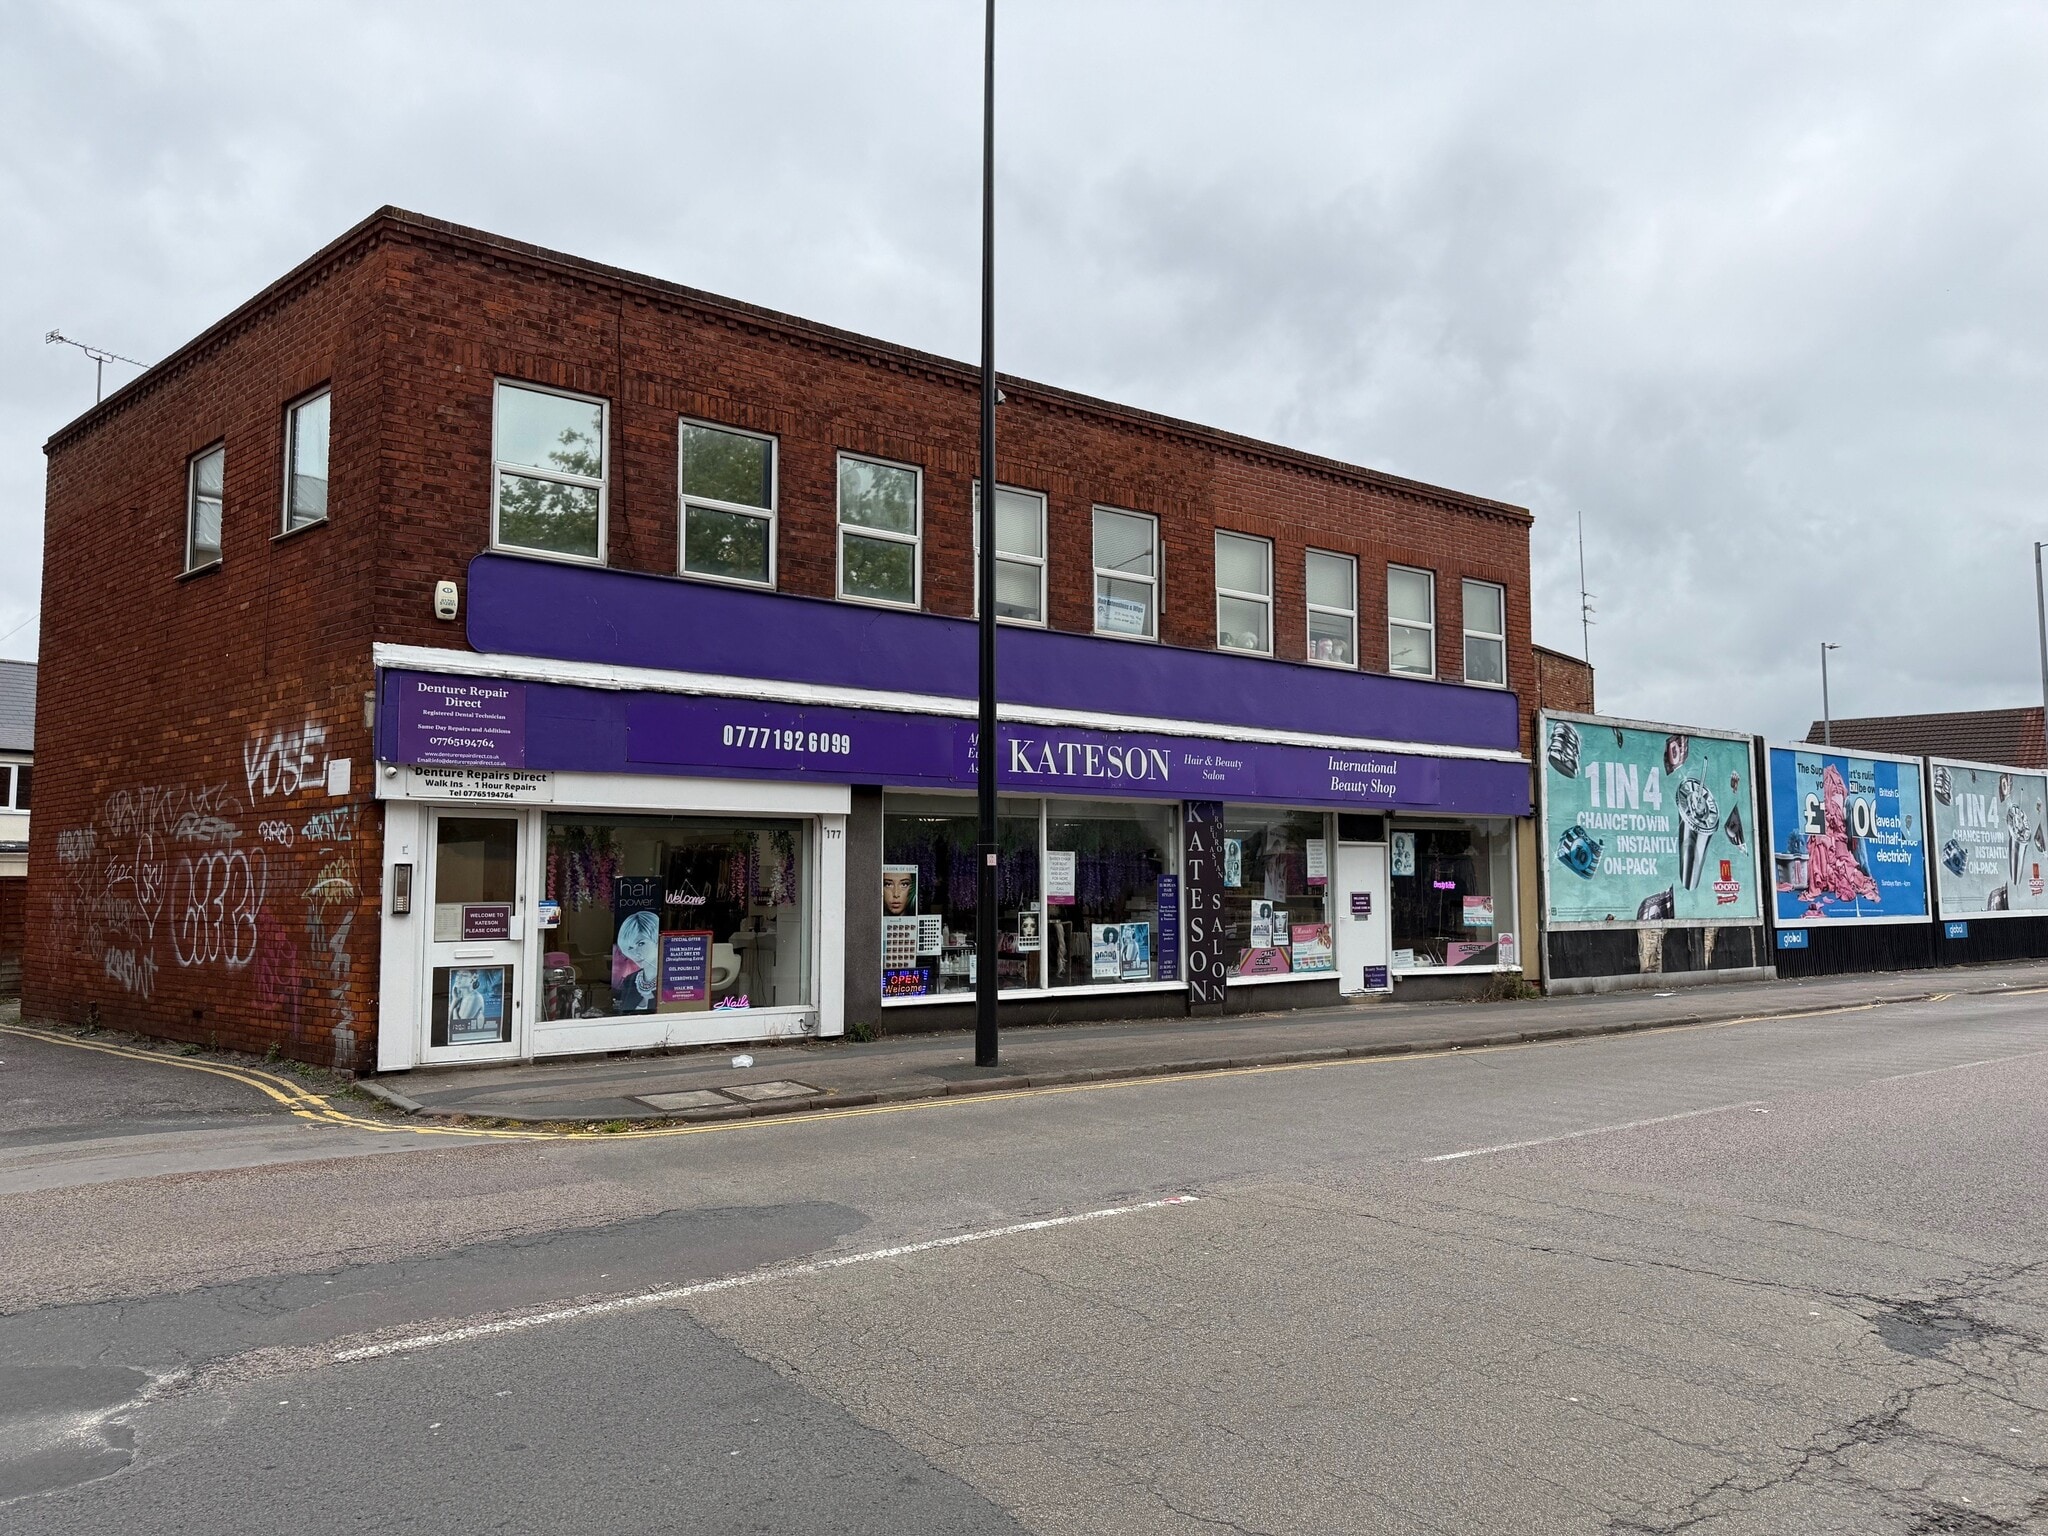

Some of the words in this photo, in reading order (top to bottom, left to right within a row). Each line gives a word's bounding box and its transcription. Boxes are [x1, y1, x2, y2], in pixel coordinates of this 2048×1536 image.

[418, 682, 467, 695] Denture
[470, 686, 509, 699] Repair
[445, 696, 482, 708] Direct
[422, 709, 454, 718] Registered
[475, 712, 506, 720] Technician
[435, 724, 447, 732] Day
[448, 725, 471, 733] Repairs
[429, 737, 495, 748] 07765194764
[425, 751, 500, 760] www.denturerepairdirect.co.uk
[1007, 738, 1171, 782] KATESON
[1184, 753, 1204, 765] Hair
[1204, 755, 1213, 766] &
[1215, 756, 1243, 771] Beauty
[1328, 755, 1397, 775] International
[1797, 762, 1809, 774] The
[415, 767, 464, 778] Denture
[467, 770, 510, 780] Repairs
[513, 771, 547, 782] Direct
[1202, 769, 1225, 781] Salon
[425, 779, 448, 787] Walk
[450, 780, 463, 788] Ins
[504, 783, 537, 792] Repairs
[1330, 776, 1369, 796] Beauty
[1370, 778, 1397, 798] Shop
[1585, 761, 1600, 808] 1
[1605, 762, 1640, 810] IN
[1643, 766, 1662, 811] 4
[1879, 787, 1894, 797] British
[463, 790, 514, 798] 07765194764
[1955, 793, 1965, 827] 1
[1966, 793, 1987, 828] IN
[1987, 796, 2000, 829] 4
[1577, 811, 1628, 831] CHANCE
[1630, 814, 1646, 831] TO
[1645, 815, 1669, 832] WIN
[826, 830, 841, 839] 177
[1952, 829, 1981, 843] CHANCE
[1981, 830, 1989, 842] TO
[1989, 831, 2004, 843] WIN
[1617, 835, 1679, 854] INSTANTLY
[1876, 848, 1912, 866] electricity
[1975, 846, 2009, 860] INSTANTLY
[1603, 857, 1658, 875] ON-PACK
[1968, 861, 1999, 875] ON-PACK
[620, 878, 656, 897] hair
[1714, 883, 1739, 891] MONOPOLY
[620, 898, 654, 908] power
[665, 889, 707, 905] Welcome
[1187, 801, 1208, 1003] KATESON
[1949, 924, 1963, 938] global
[1783, 931, 1801, 948] global
[1211, 893, 1225, 1001] SALON
[890, 975, 920, 985] OPEN
[885, 985, 923, 993] Welcome
[713, 994, 750, 1008] Nails
